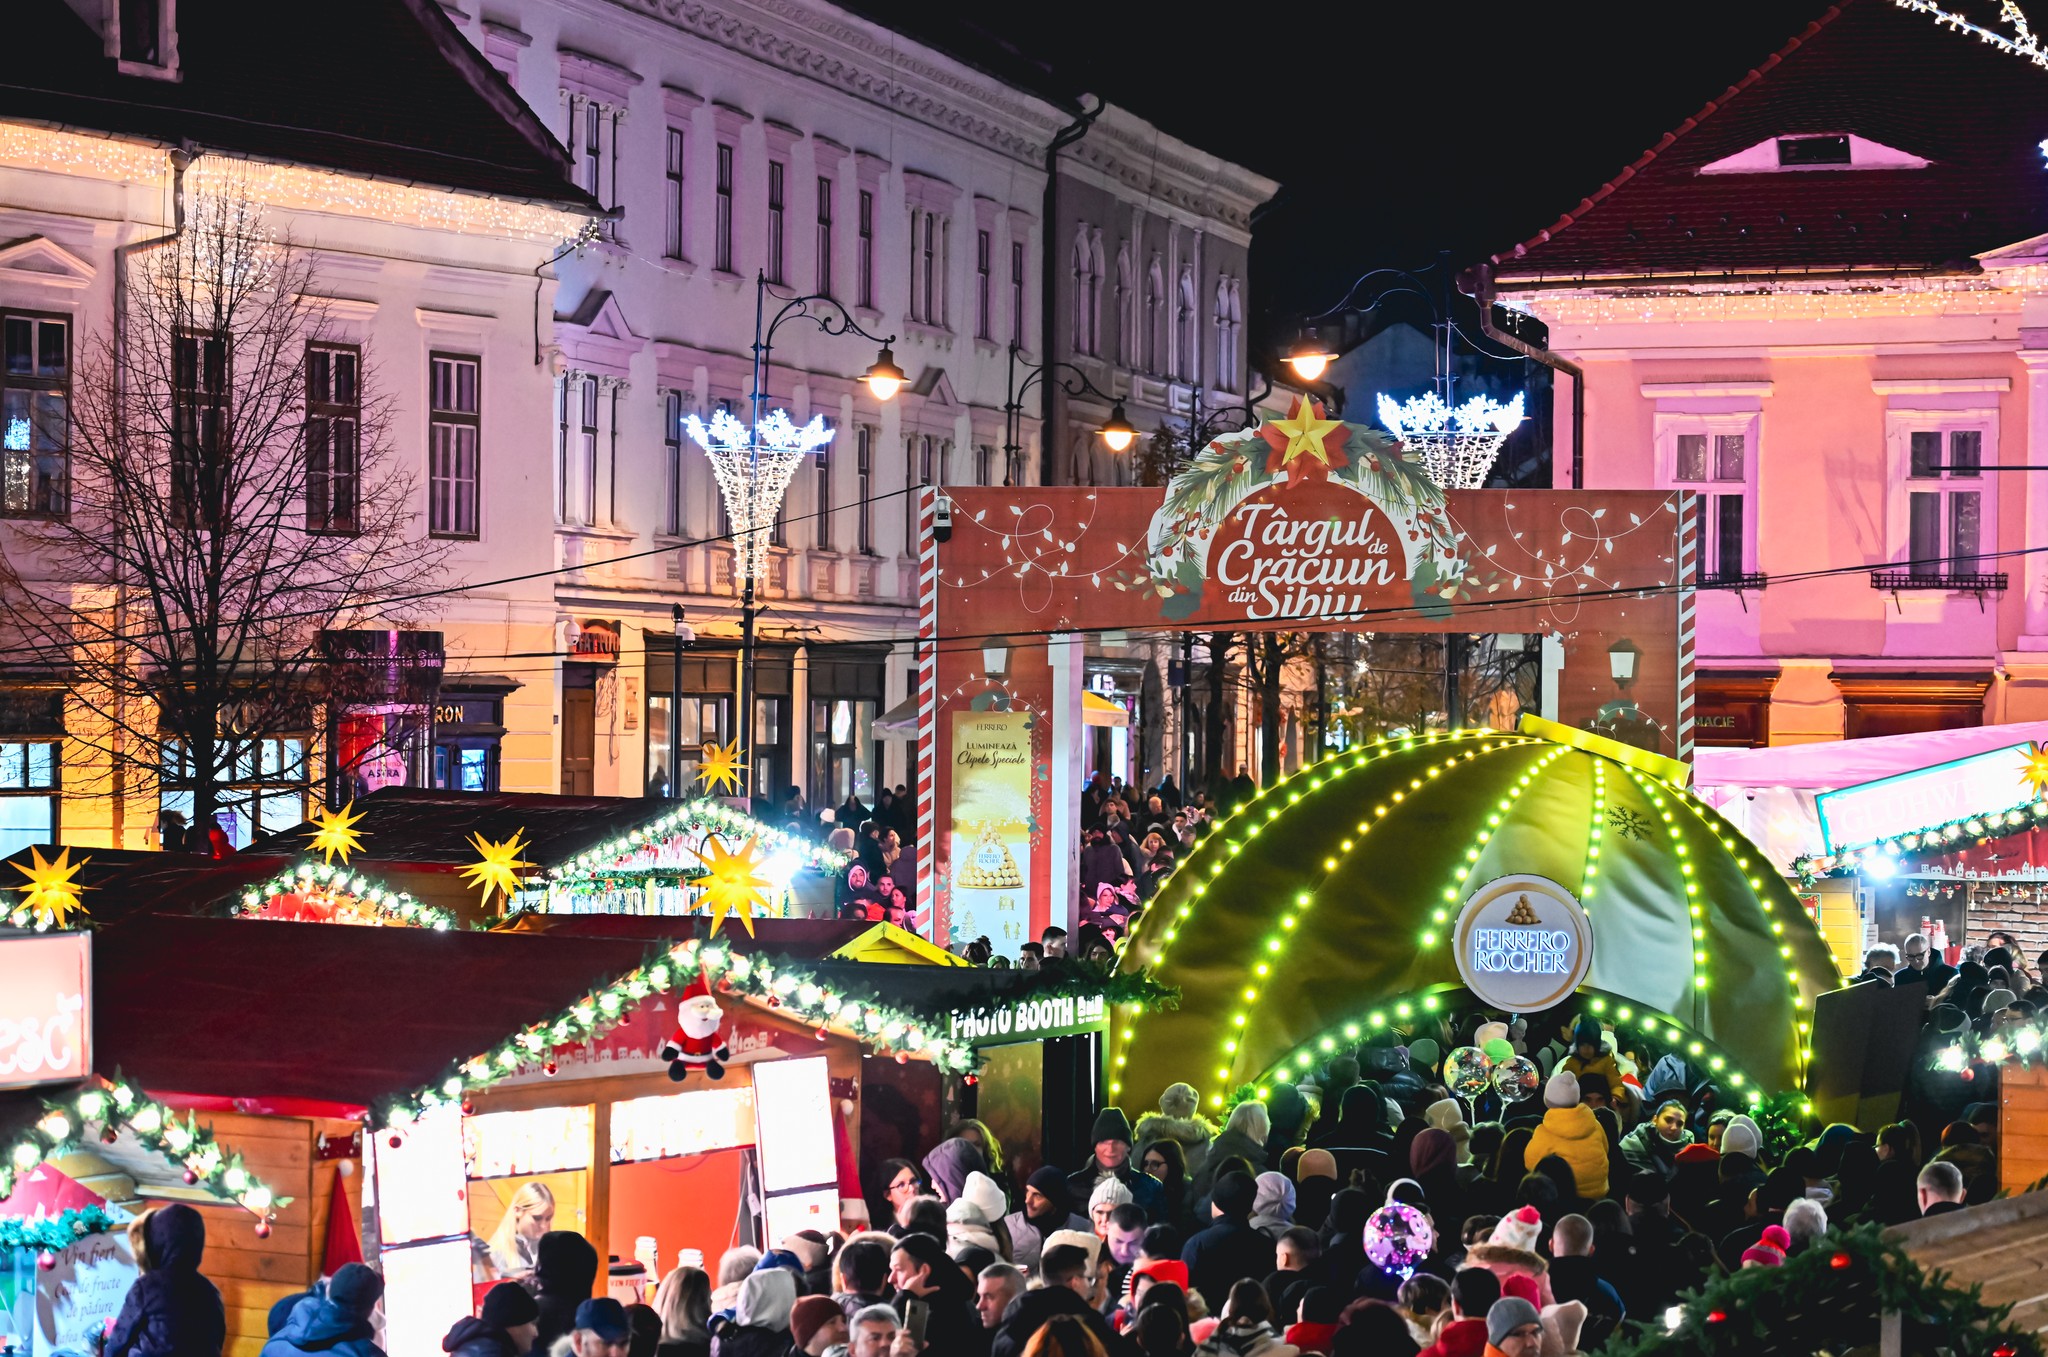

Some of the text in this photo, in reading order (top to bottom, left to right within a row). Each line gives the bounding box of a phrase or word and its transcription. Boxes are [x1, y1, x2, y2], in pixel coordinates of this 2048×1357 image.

[1236, 503, 1389, 558] Târgul de
[1217, 540, 1396, 586] Crăciun
[1228, 576, 1369, 621] din Sibiu
[976, 723, 1008, 731] FERRERO
[991, 750, 1027, 768] Speciale
[1474, 929, 1570, 952] FERRERO
[1474, 951, 1570, 974] ROCHER
[1015, 997, 1074, 1032] BOOTH
[62, 1242, 116, 1268] Vin fiert
[90, 1276, 121, 1297] fructe
